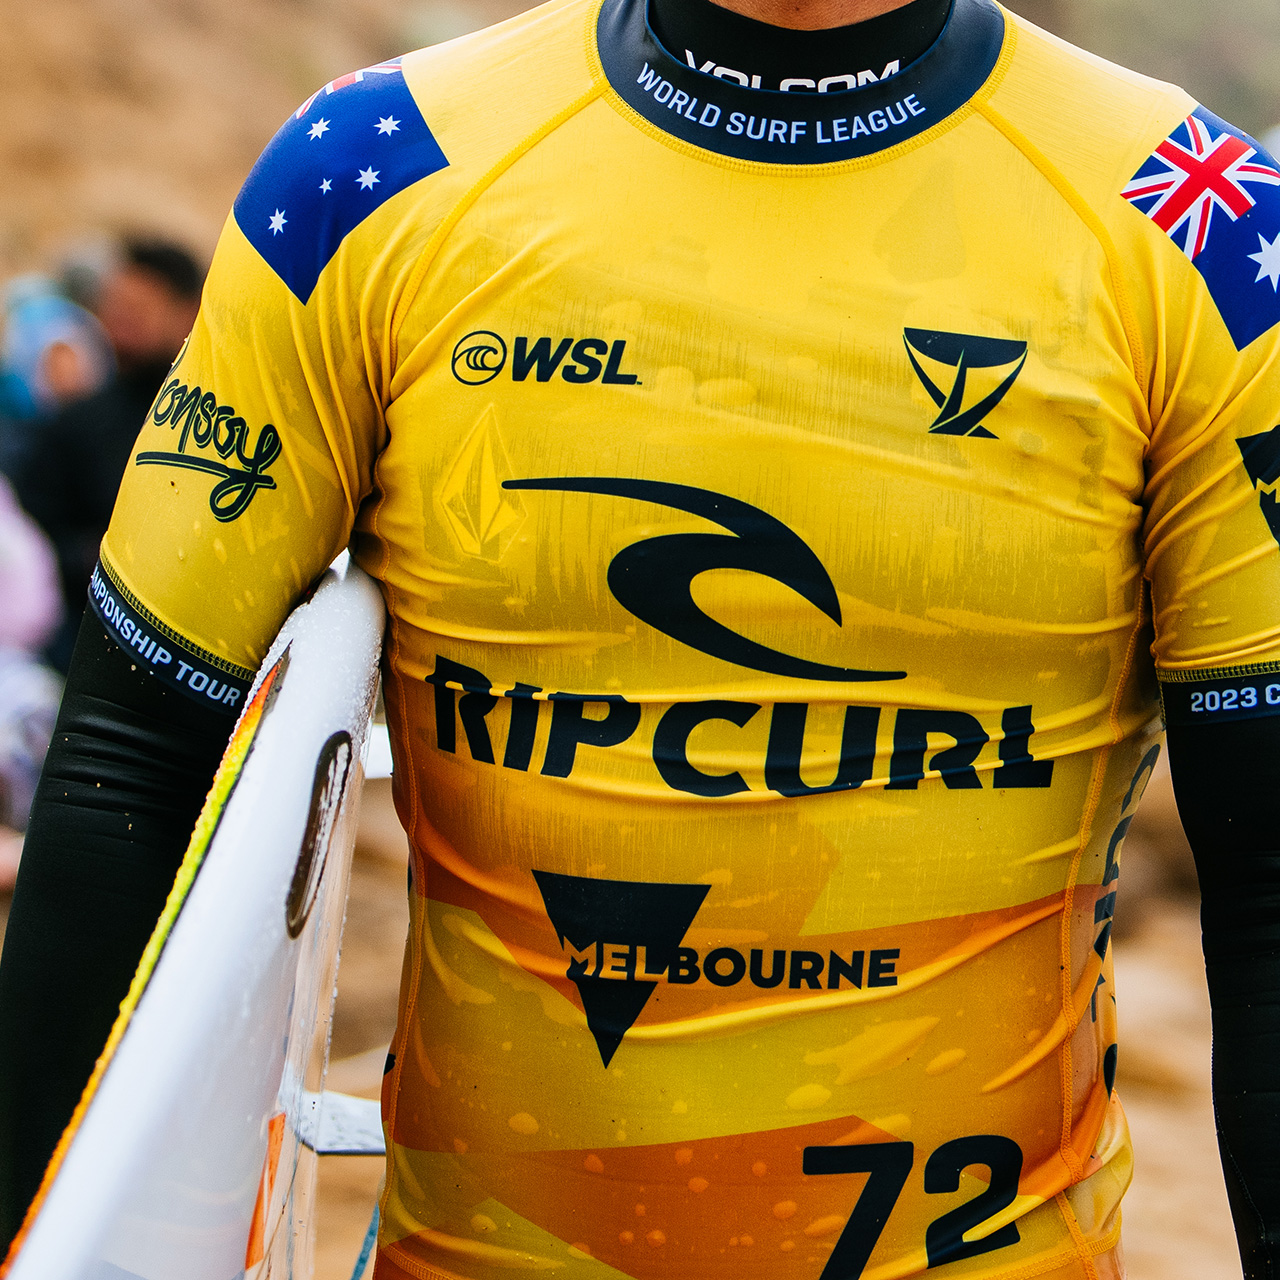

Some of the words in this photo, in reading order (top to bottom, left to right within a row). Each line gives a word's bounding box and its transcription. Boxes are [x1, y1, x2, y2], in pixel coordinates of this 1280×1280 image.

[636, 62, 721, 129] WORLD
[725, 112, 807, 144] SURF
[816, 93, 926, 144] LEAGUE
[512, 336, 638, 385] WSL
[140, 350, 283, 523] onsoy
[175, 660, 241, 707] TOUR
[1190, 686, 1258, 712] 2023
[426, 654, 641, 778] RIP
[652, 699, 1055, 798] CURL
[561, 934, 901, 990] MELBOURNE
[802, 1134, 1024, 1280] 72
